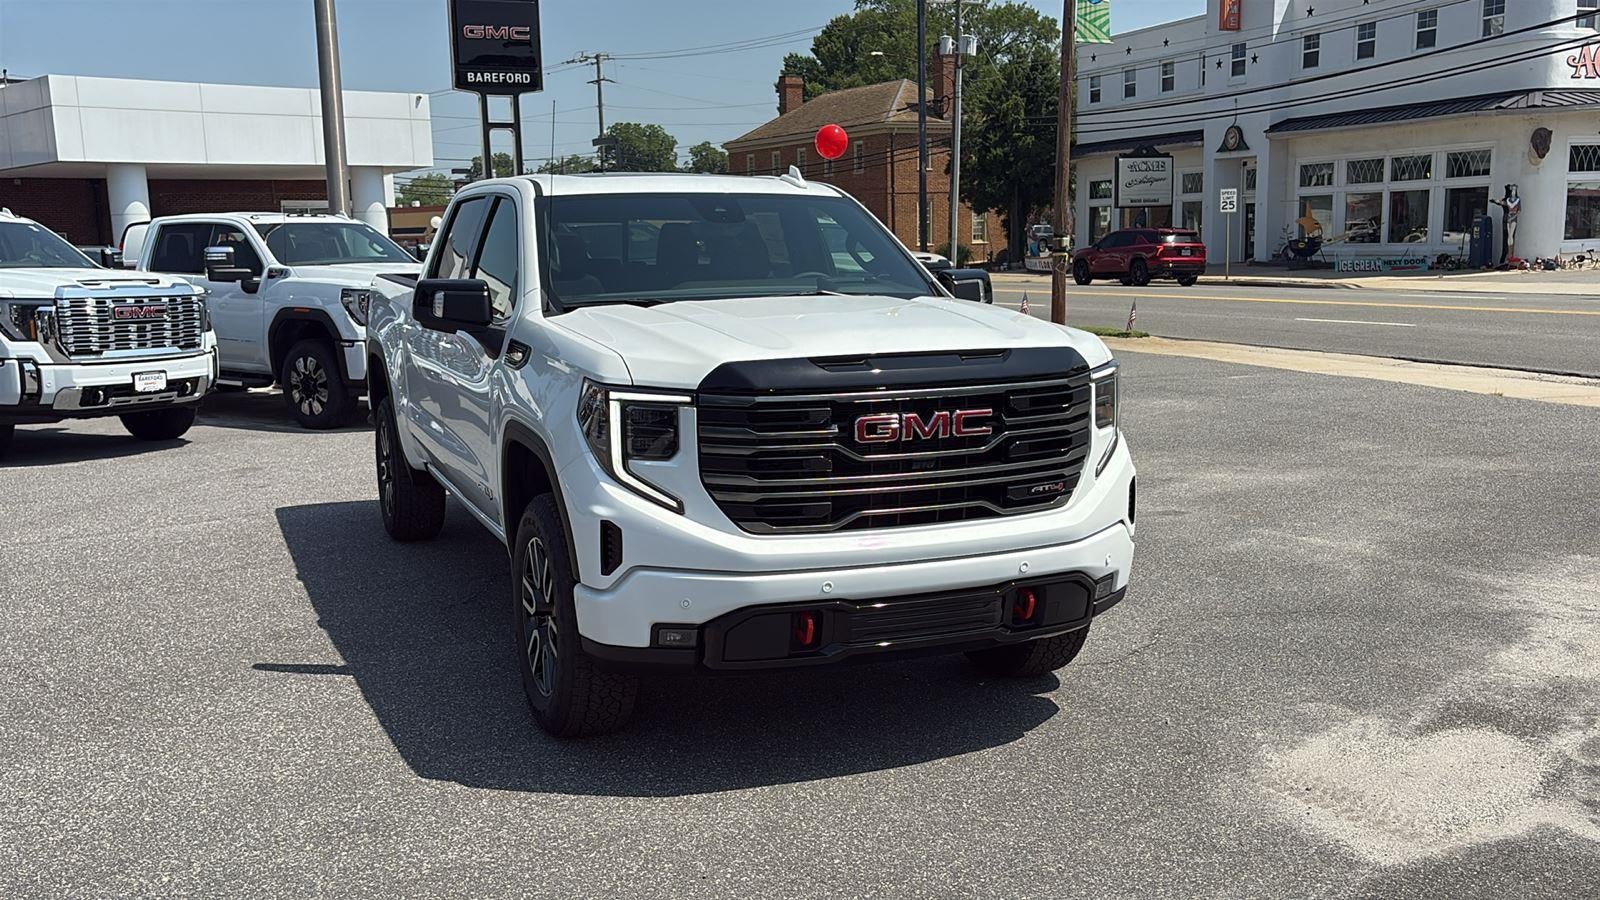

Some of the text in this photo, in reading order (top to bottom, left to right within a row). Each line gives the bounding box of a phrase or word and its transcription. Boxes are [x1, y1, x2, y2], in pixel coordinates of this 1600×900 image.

[463, 25, 530, 40] GMC
[467, 72, 531, 83] BAREFORD
[1221, 200, 1235, 210] 25
[115, 306, 166, 318] GMC
[855, 409, 993, 443] GMC
[1031, 482, 1064, 493] AT4
